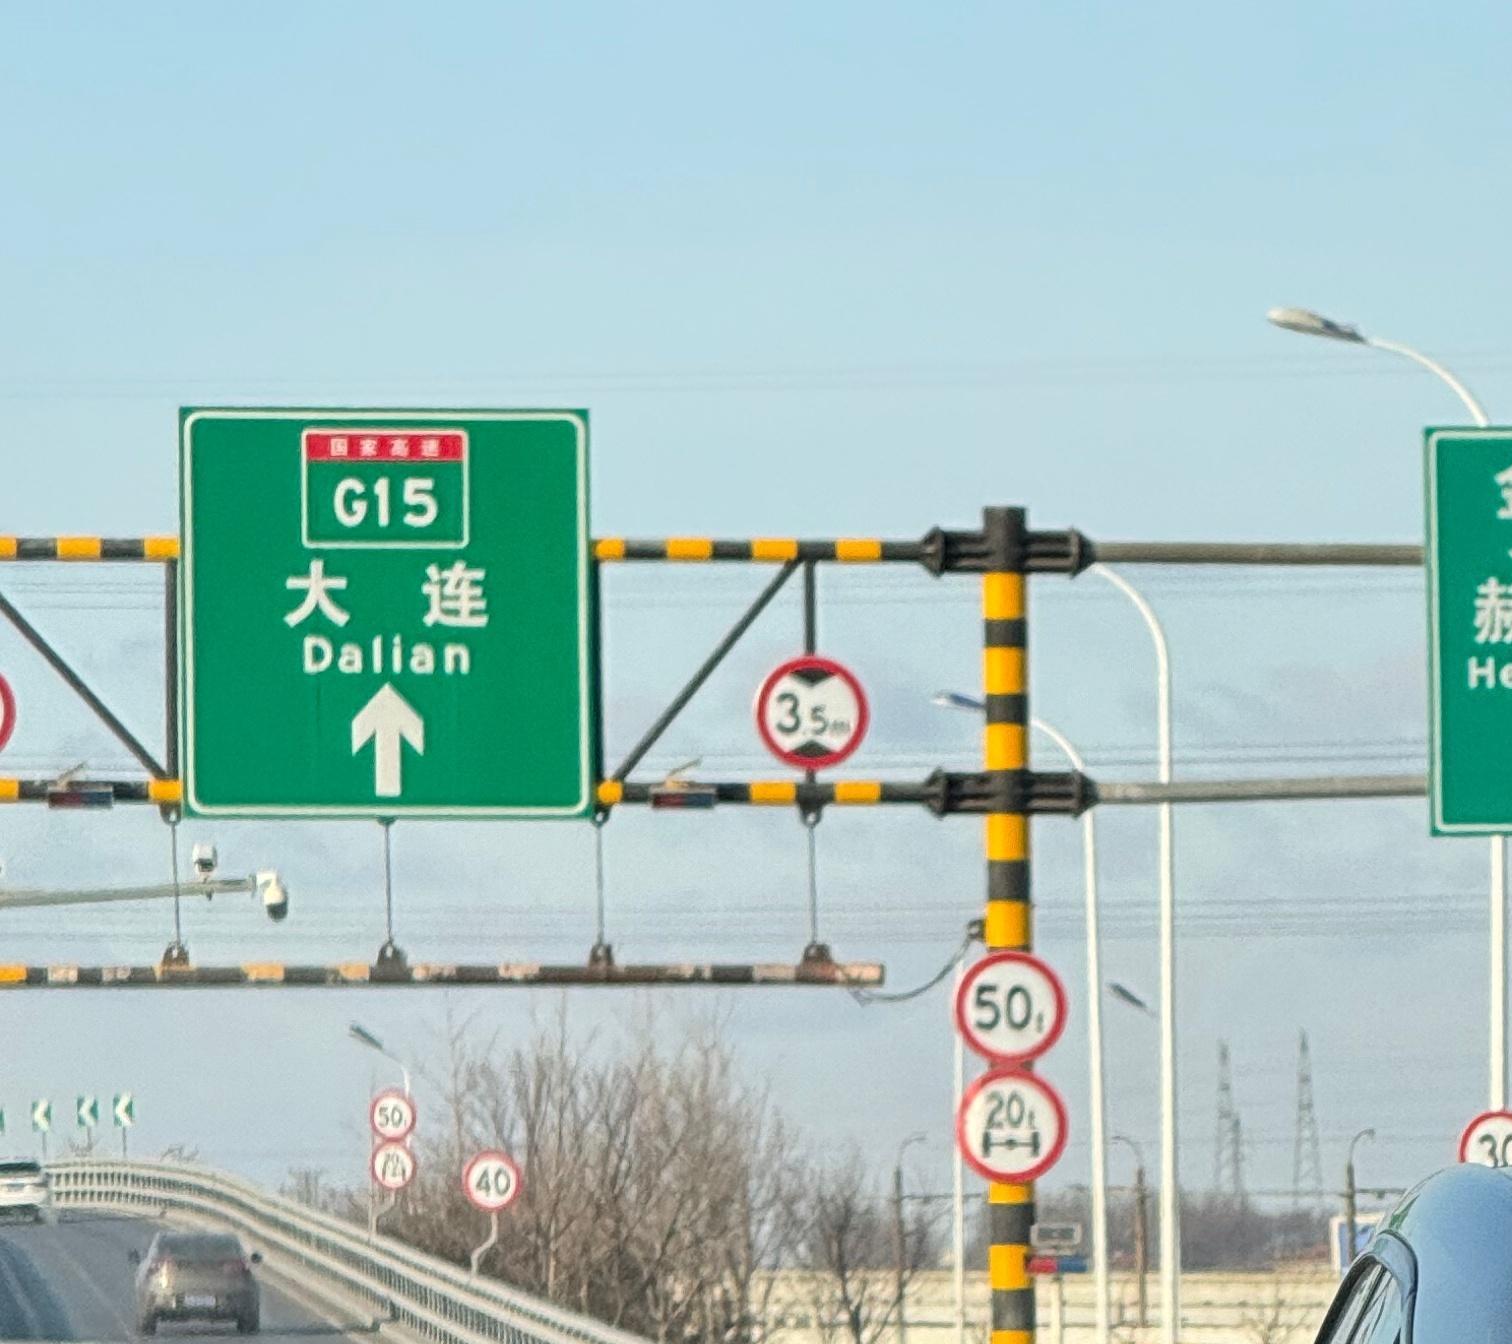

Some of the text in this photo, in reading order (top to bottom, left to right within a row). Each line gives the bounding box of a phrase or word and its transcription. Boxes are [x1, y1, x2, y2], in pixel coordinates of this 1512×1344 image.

[333, 476, 438, 528] G15
[283, 558, 489, 629] 大连
[302, 632, 470, 675] Dalian
[475, 1166, 511, 1198] 40
